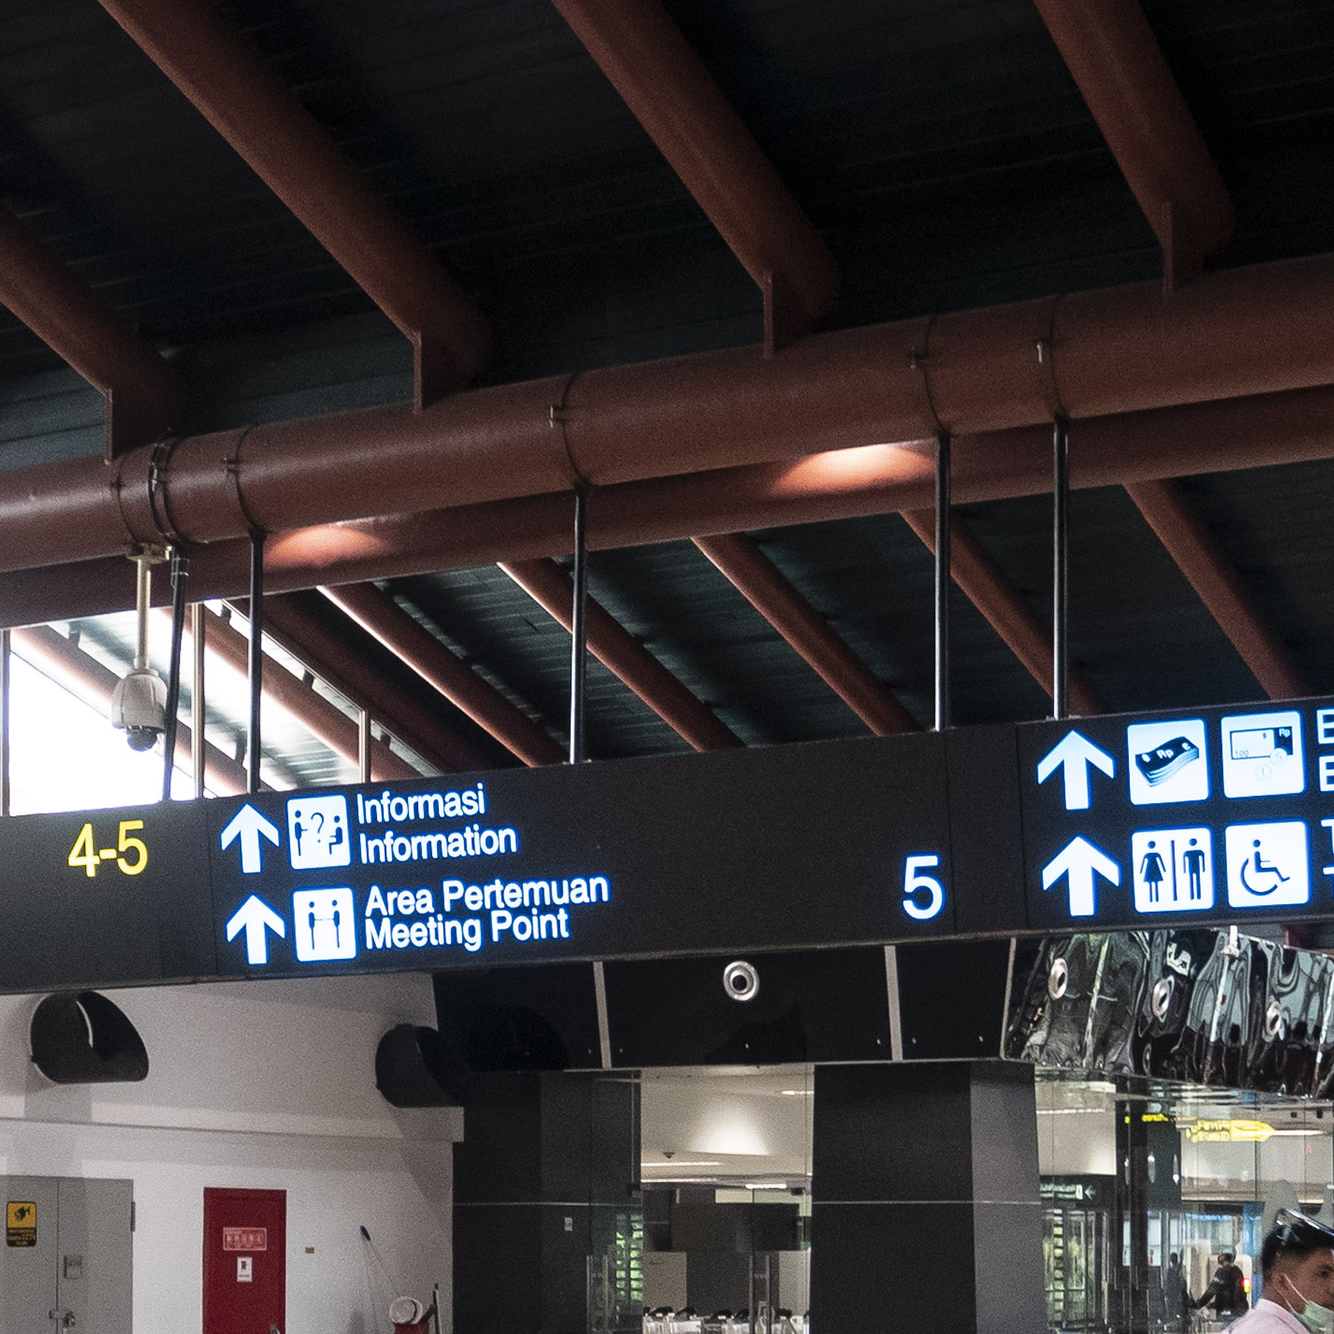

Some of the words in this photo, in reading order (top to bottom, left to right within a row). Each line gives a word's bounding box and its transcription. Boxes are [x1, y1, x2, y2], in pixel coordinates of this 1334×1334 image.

[357, 782, 487, 824] Informasi
[68, 820, 148, 878] 4-5
[359, 824, 519, 864] Information
[365, 885, 435, 917] Area
[443, 876, 610, 914] Pertemuan
[902, 854, 946, 920] 5
[366, 914, 482, 953] Meeting
[491, 907, 570, 942] Point
